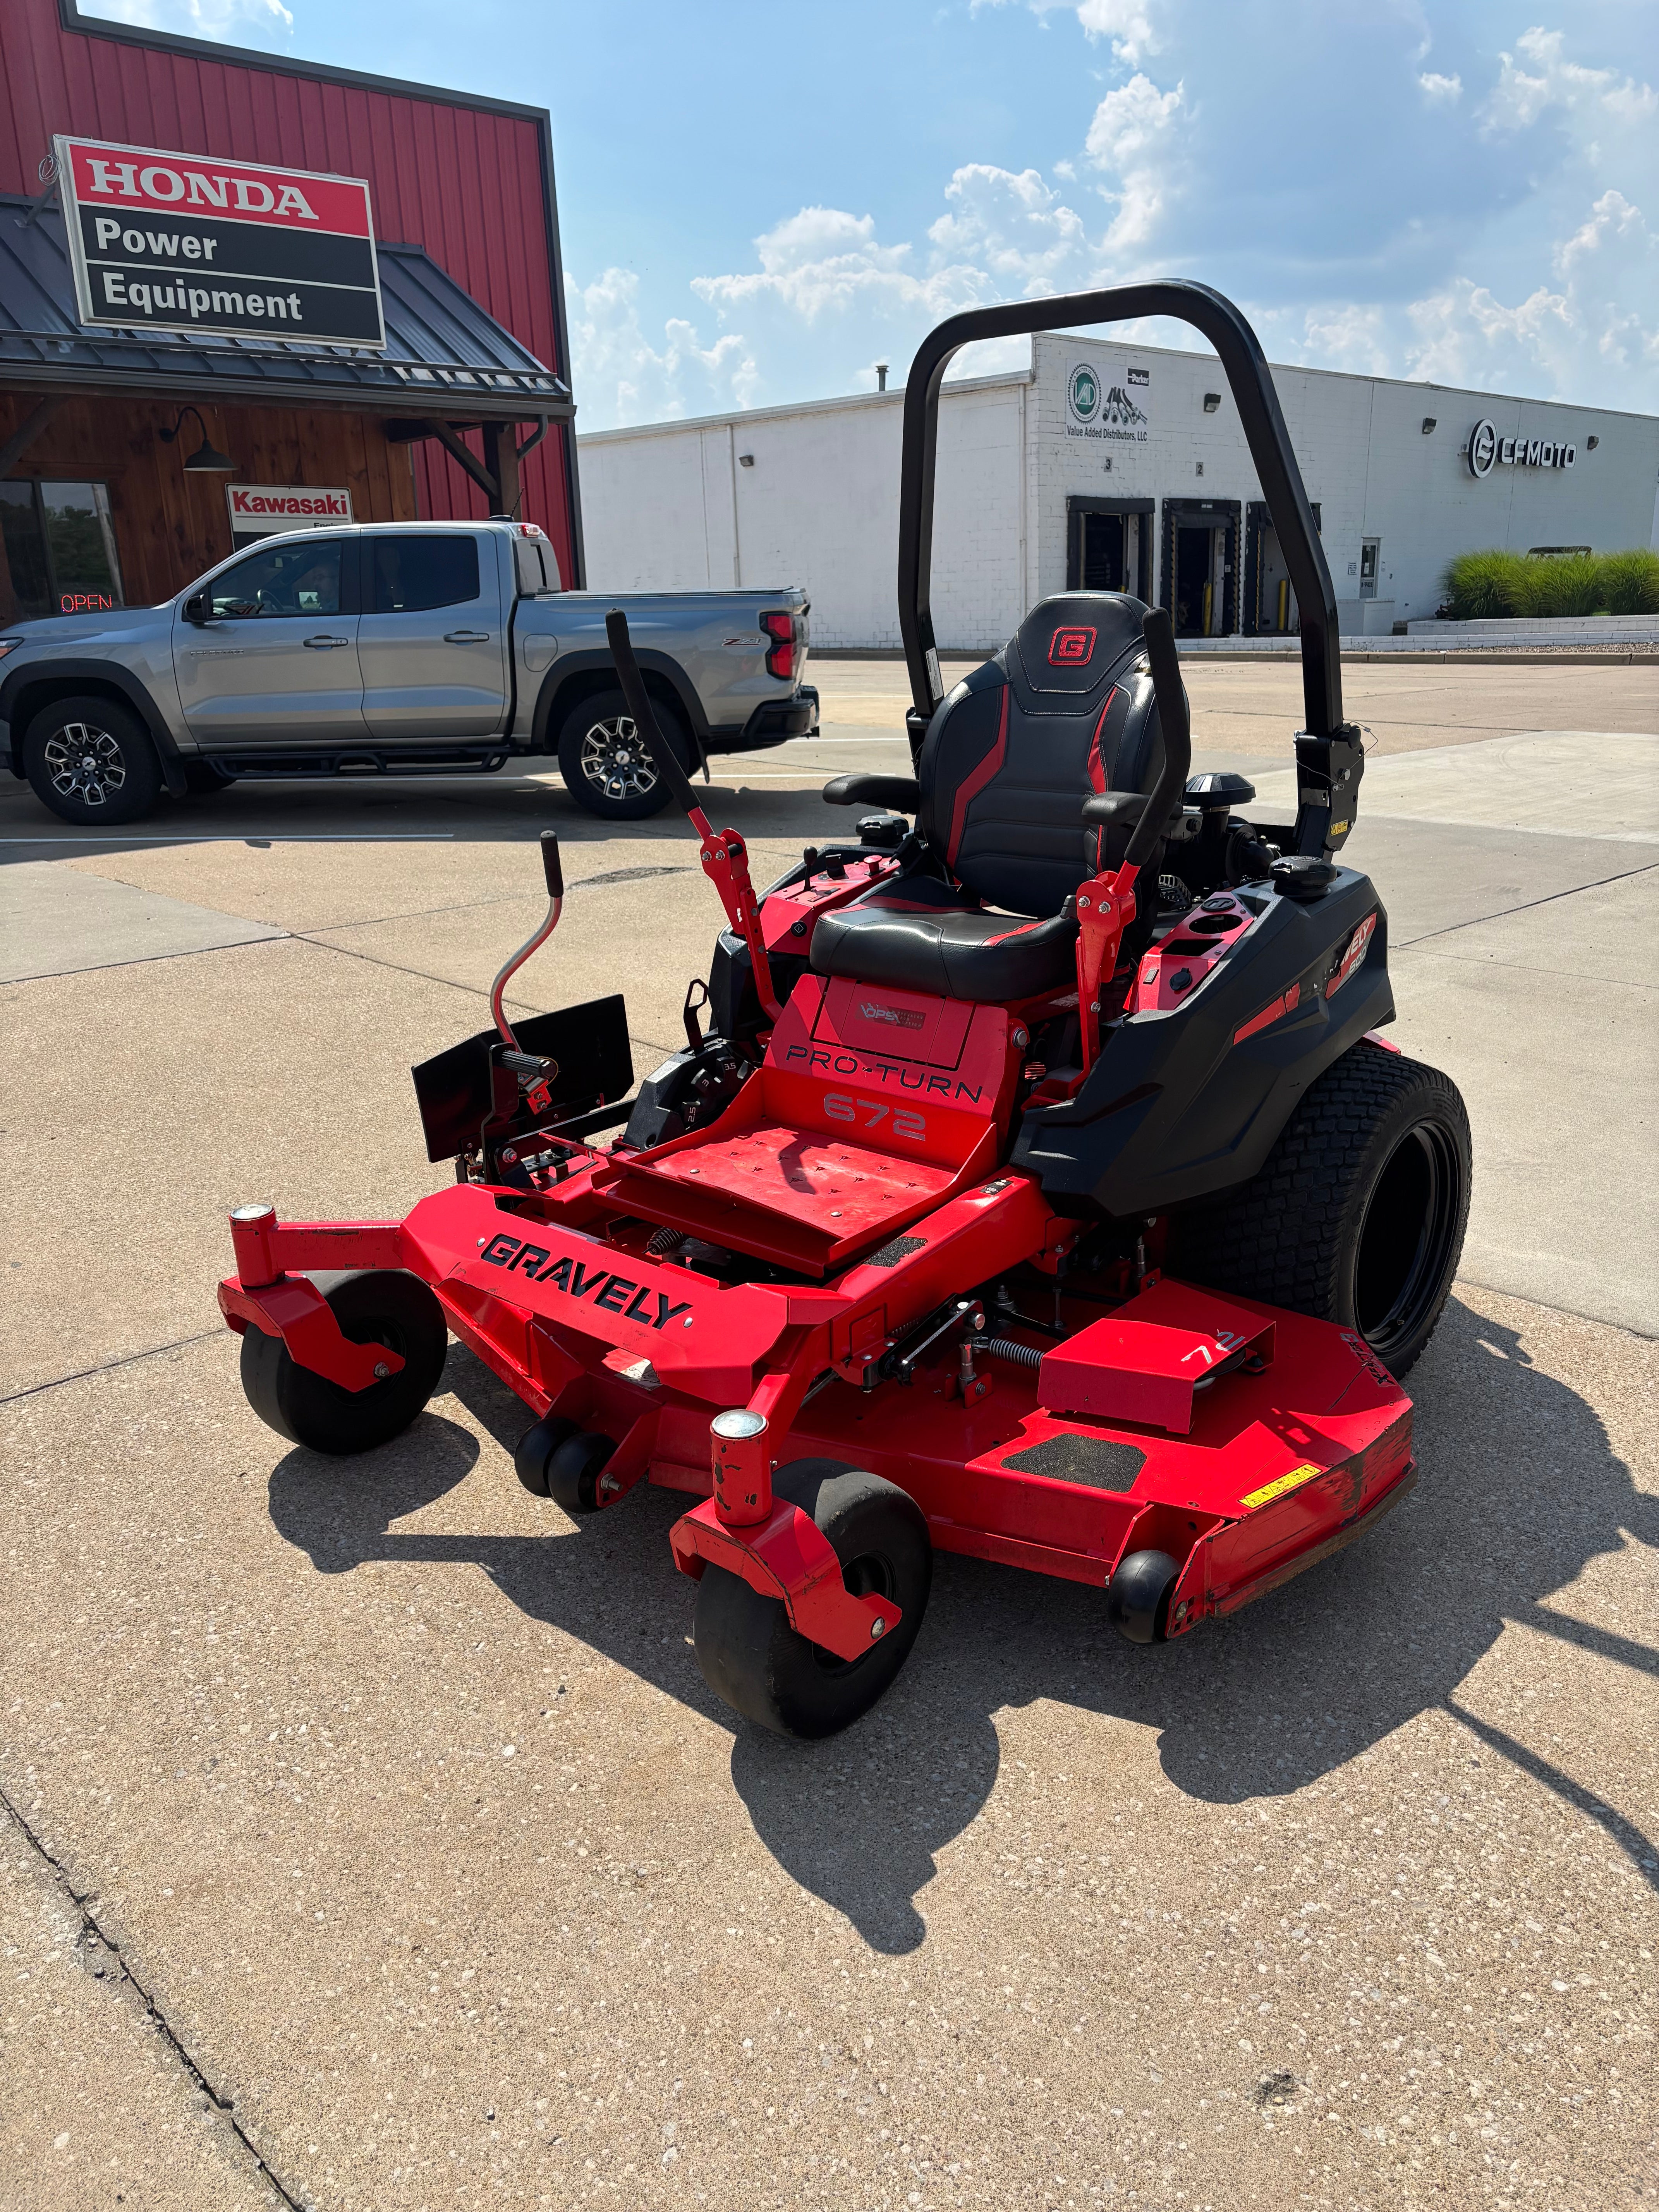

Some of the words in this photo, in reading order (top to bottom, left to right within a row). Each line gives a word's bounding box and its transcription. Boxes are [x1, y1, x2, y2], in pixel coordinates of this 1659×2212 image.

[86, 158, 319, 220] HONDA
[95, 217, 217, 261] Power
[102, 272, 302, 320] Equipment
[1131, 373, 1149, 383] Parker
[1067, 425, 1083, 436] Value
[1084, 427, 1102, 438] Added
[1103, 428, 1136, 441] Distributors,
[1137, 431, 1147, 441] LLC
[1498, 437, 1577, 468] CFMOTO
[1105, 459, 1111, 470] 3
[1197, 464, 1202, 474] 2
[232, 491, 348, 515] Kawasaki
[721, 638, 762, 646] Z71
[724, 1062, 736, 1070] 3.5
[786, 1045, 982, 1103] PRO-TURN
[702, 1079, 709, 1087] 3
[688, 1107, 696, 1122] 2.5
[824, 1093, 926, 1141] 672
[481, 1233, 693, 1329] GRAVELY
